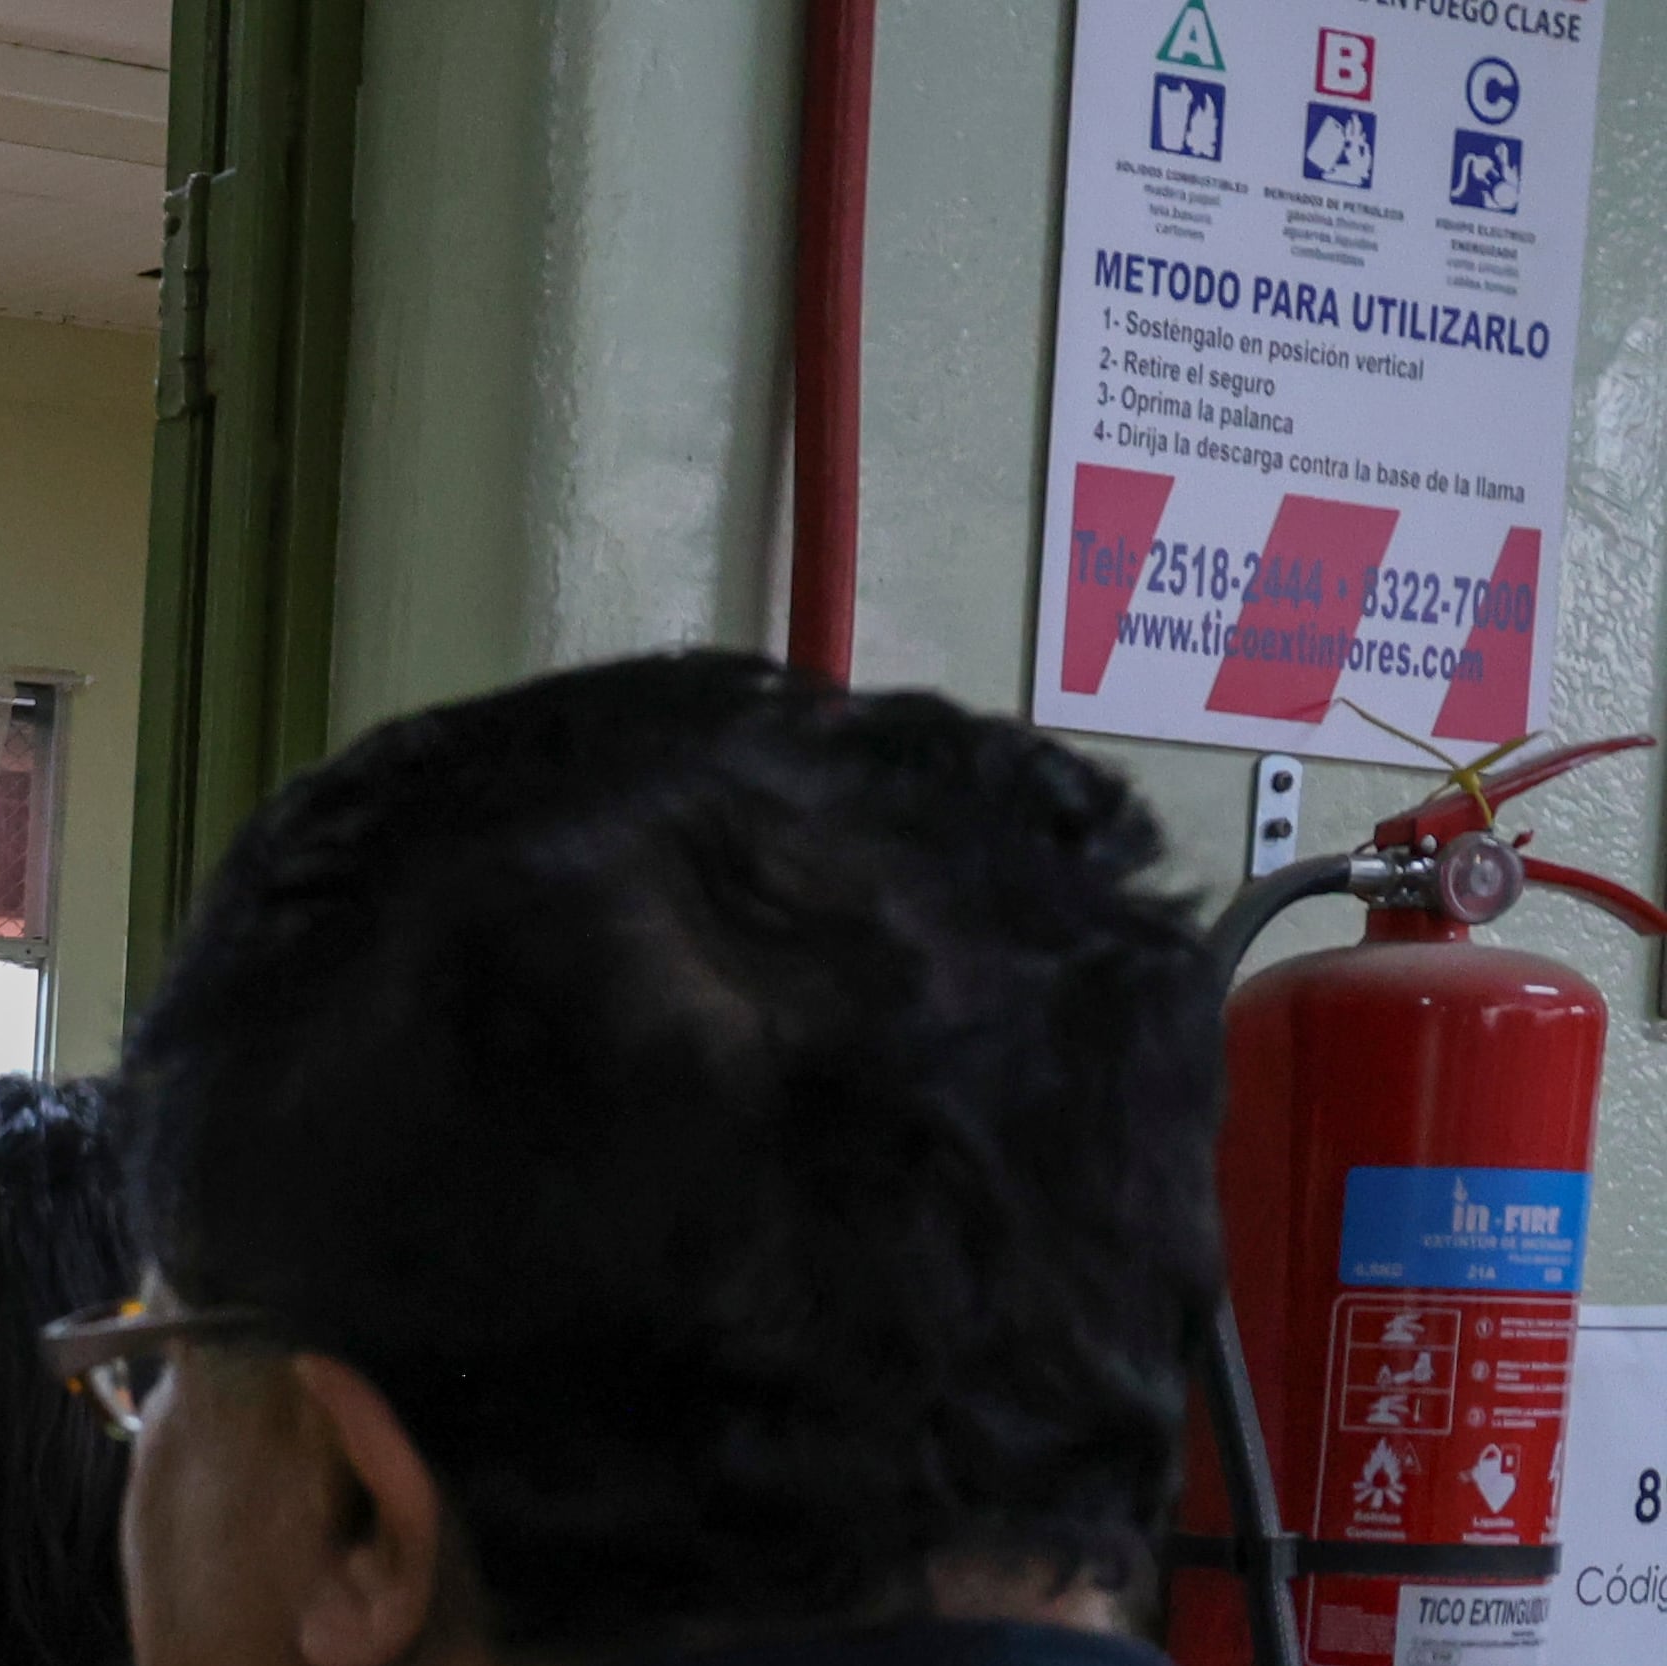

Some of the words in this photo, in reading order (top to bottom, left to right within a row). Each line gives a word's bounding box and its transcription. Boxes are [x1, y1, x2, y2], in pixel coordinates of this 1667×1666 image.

[1504, 3, 1581, 42] CLASE
[1323, 30, 1370, 97] B
[1471, 60, 1517, 120] C
[1095, 249, 1241, 309] METODO
[1252, 275, 1340, 328] PARA
[1352, 291, 1550, 360] UTILIZARLO
[1099, 346, 1117, 371] 2-
[1124, 350, 1181, 383] Retire
[1186, 363, 1204, 385] el
[1209, 370, 1276, 398] seguro
[1102, 305, 1120, 331] 1-
[1125, 309, 1235, 352] Sosténgalo
[1239, 335, 1263, 355] en
[1268, 338, 1350, 369] posición
[1354, 354, 1424, 381] vertical
[1097, 381, 1115, 406] 3-
[1121, 385, 1192, 418] Oprima
[1197, 398, 1214, 422] la
[1219, 404, 1294, 435] palanca
[1093, 418, 1113, 442] 4-
[1117, 421, 1168, 457] Dirija
[1173, 431, 1191, 455] la
[1196, 436, 1284, 475] descarga
[1289, 453, 1349, 480] contra
[1354, 458, 1371, 482] la
[1376, 461, 1421, 490] base
[1425, 469, 1449, 494] de
[1454, 473, 1471, 497] la
[1476, 476, 1525, 503] llama
[1074, 530, 1137, 590] Tel:
[1147, 538, 1323, 612] 2518-2444
[1361, 565, 1534, 634] 8322-7000
[1115, 609, 1484, 683] www.ticoextintores.com
[1634, 1467, 1667, 1525] 8
[1418, 1597, 1466, 1625] TICO
